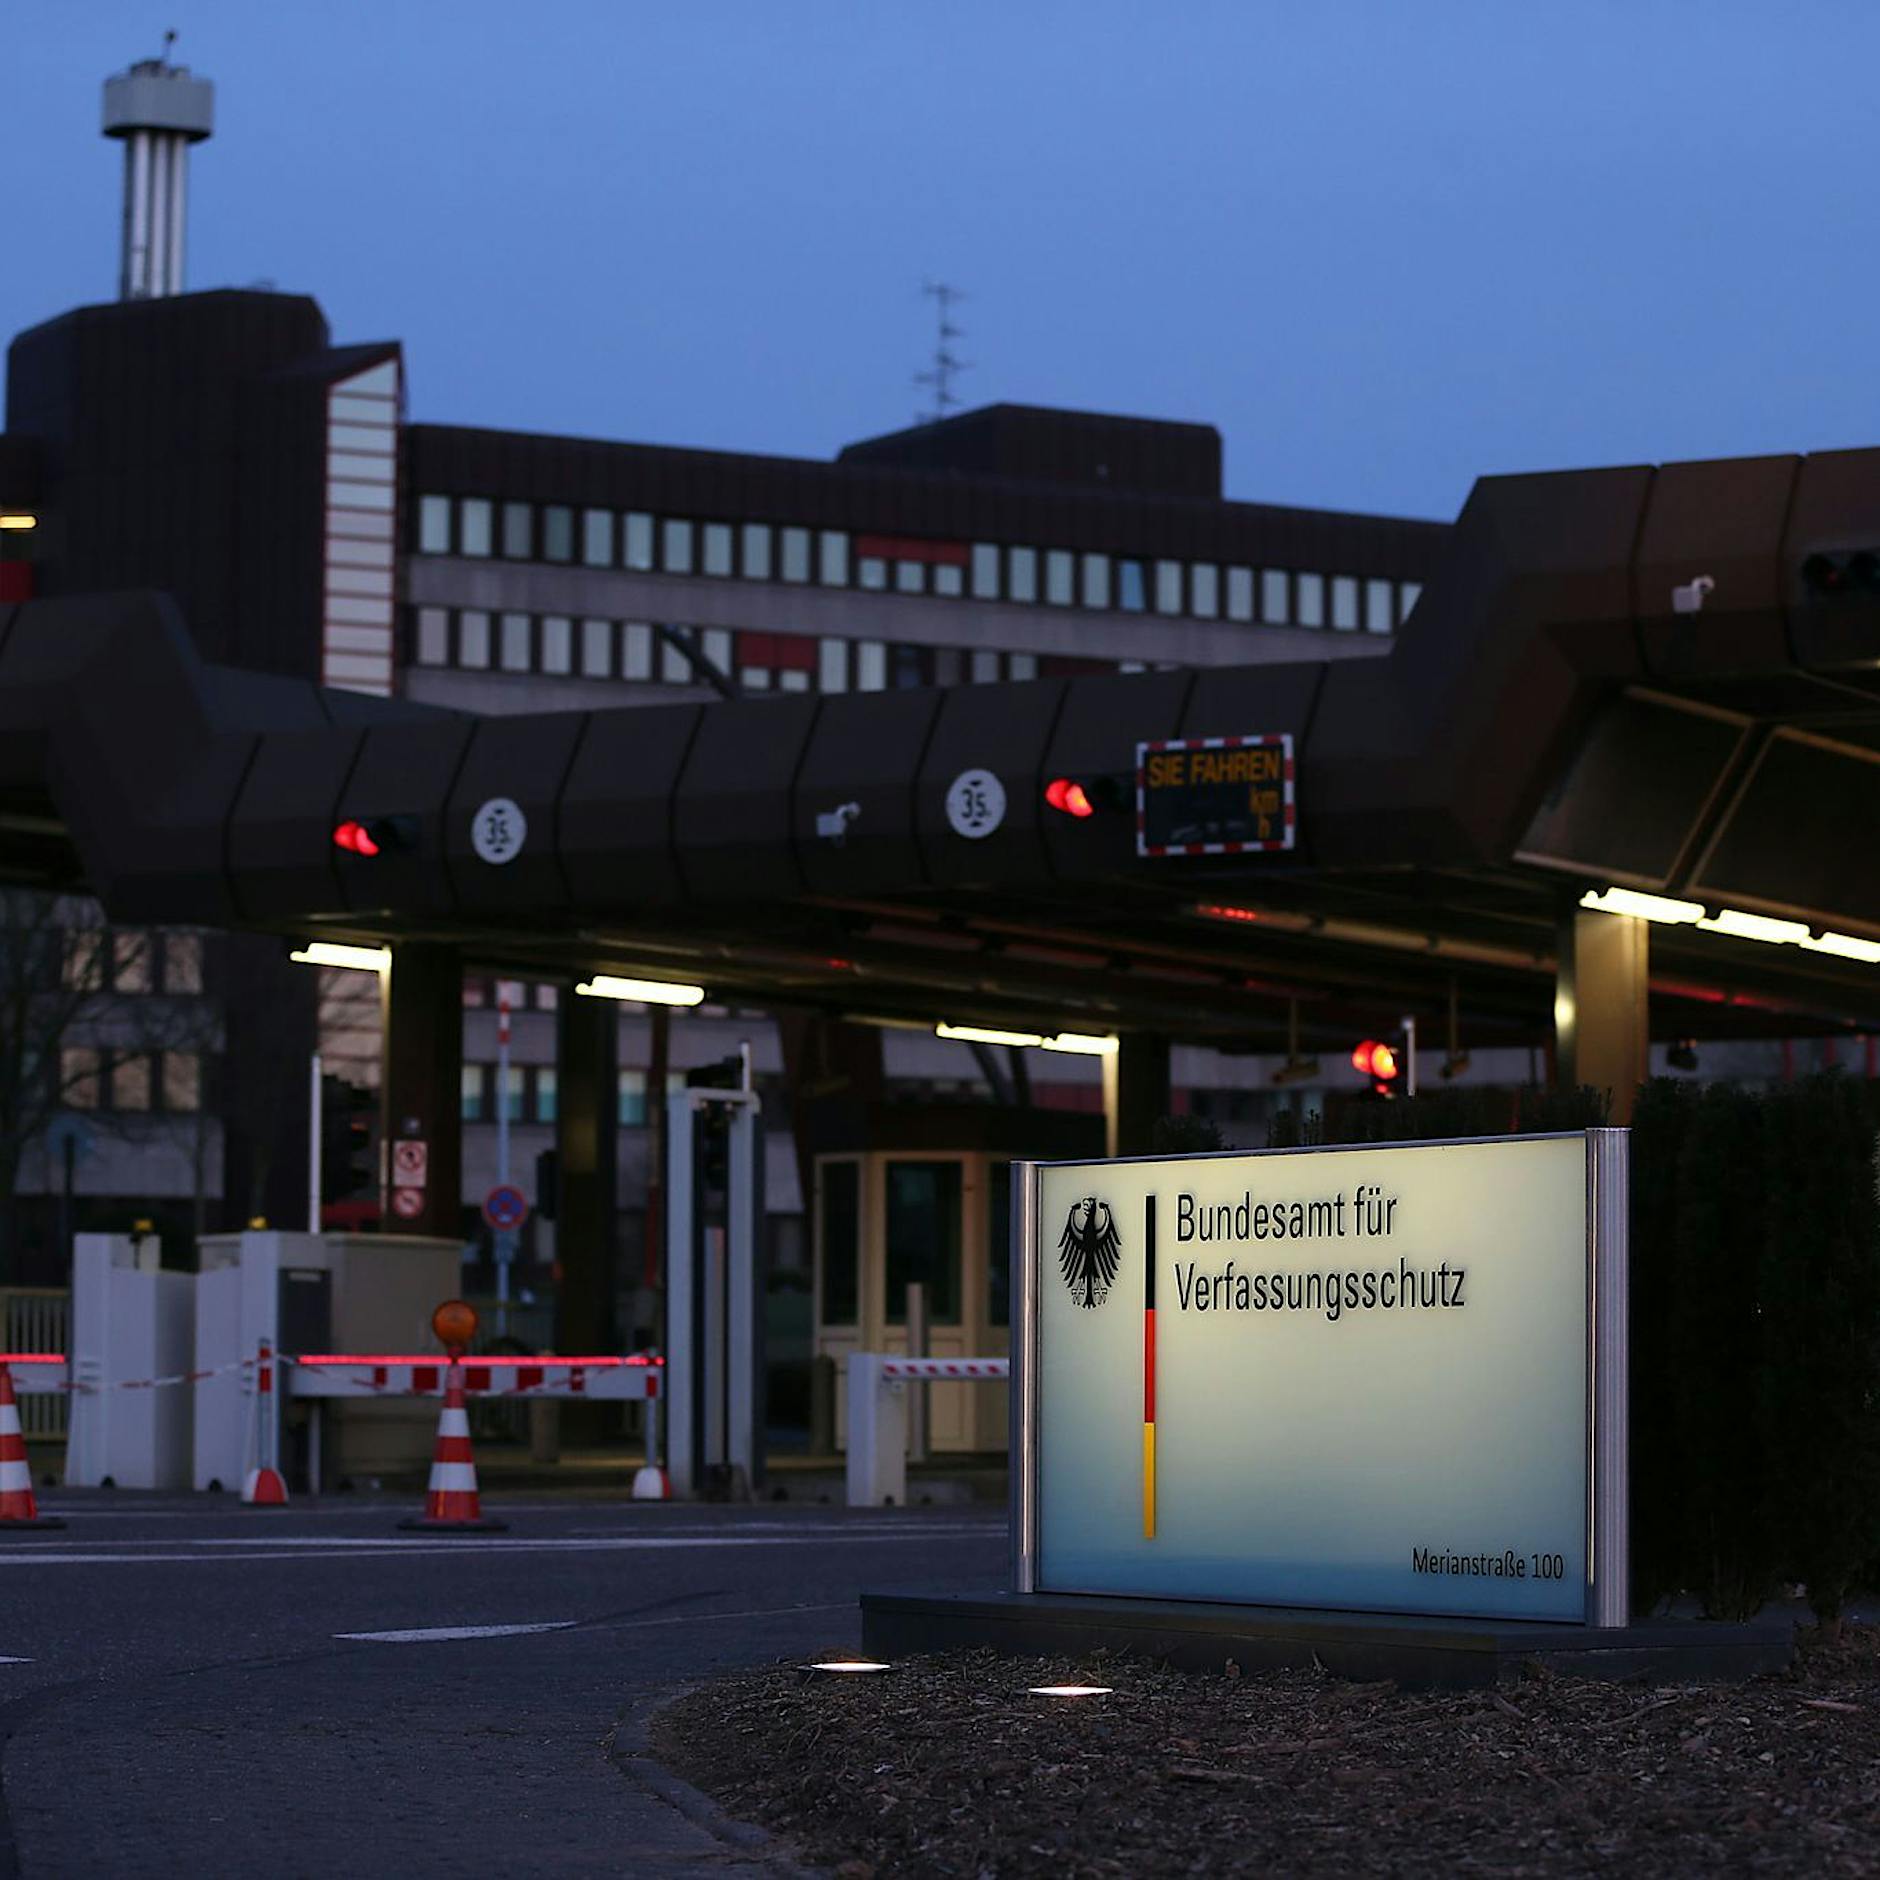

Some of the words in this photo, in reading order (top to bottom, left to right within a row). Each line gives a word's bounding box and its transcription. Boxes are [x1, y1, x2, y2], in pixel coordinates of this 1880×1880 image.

[1148, 754, 1185, 789] SIE
[1189, 750, 1281, 785] FAHREN
[1250, 787, 1280, 816] km
[1177, 1191, 1346, 1242] Bundesamt
[1353, 1186, 1398, 1236] für
[1175, 1257, 1466, 1321] Verfassungsschutz
[1412, 1547, 1526, 1579] Merianstraße
[1531, 1552, 1564, 1580] 100
